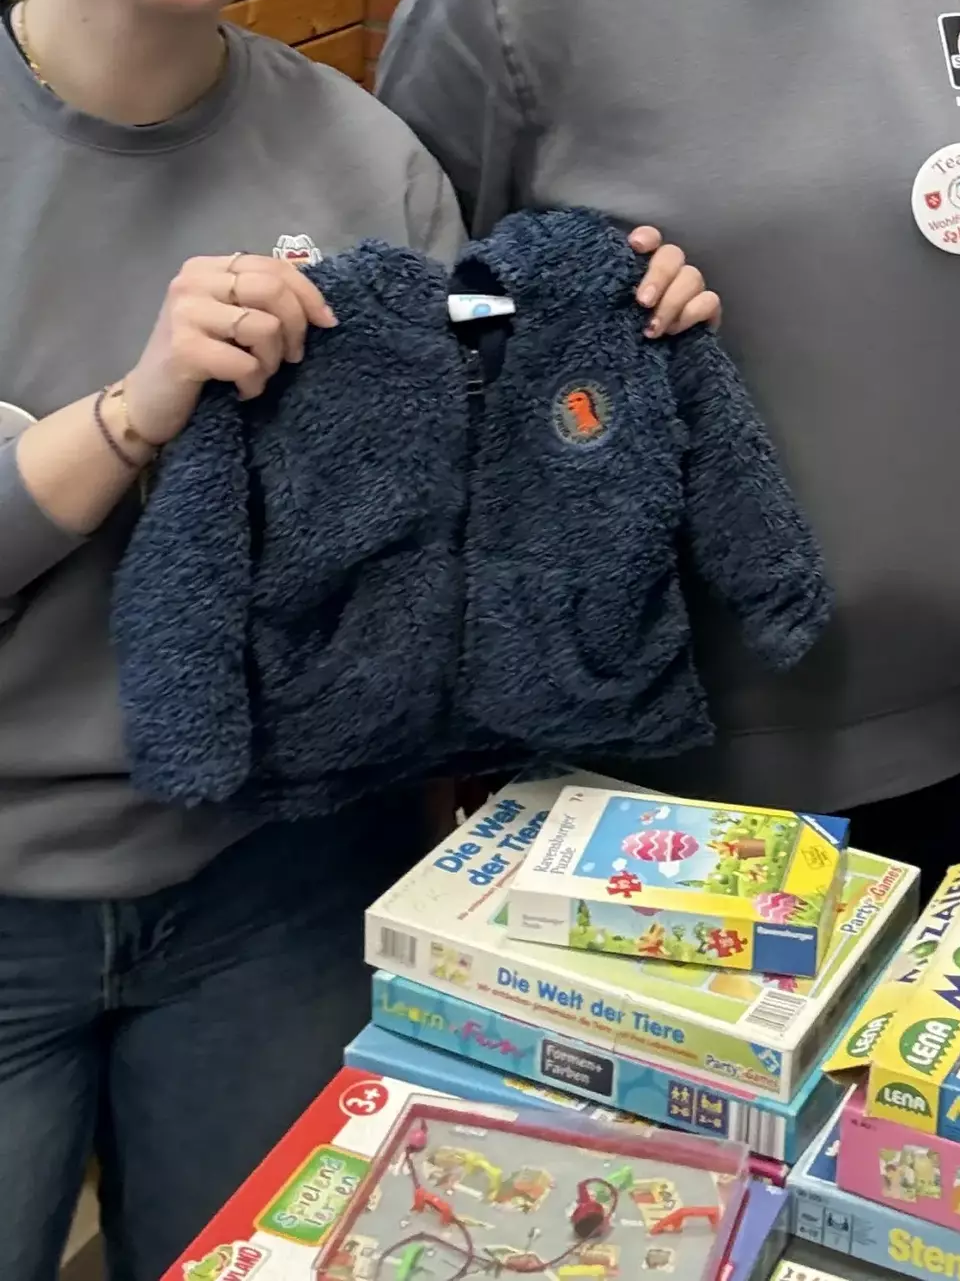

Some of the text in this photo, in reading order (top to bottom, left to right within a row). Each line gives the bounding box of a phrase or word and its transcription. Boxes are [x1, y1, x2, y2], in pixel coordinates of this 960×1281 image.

[433, 799, 526, 874] Die Welt
[533, 814, 577, 873] Ravensburger
[467, 853, 511, 886] der
[550, 847, 576, 874] Puzzle
[840, 866, 903, 934] Party Games
[497, 967, 530, 994] Die
[537, 980, 584, 1011] Welt
[590, 998, 626, 1024] der
[632, 1010, 685, 1044] Tiere
[851, 1016, 887, 1055] LENA
[905, 1020, 953, 1066] LENA
[345, 1087, 381, 1113] 3+
[883, 1087, 926, 1112] LENA
